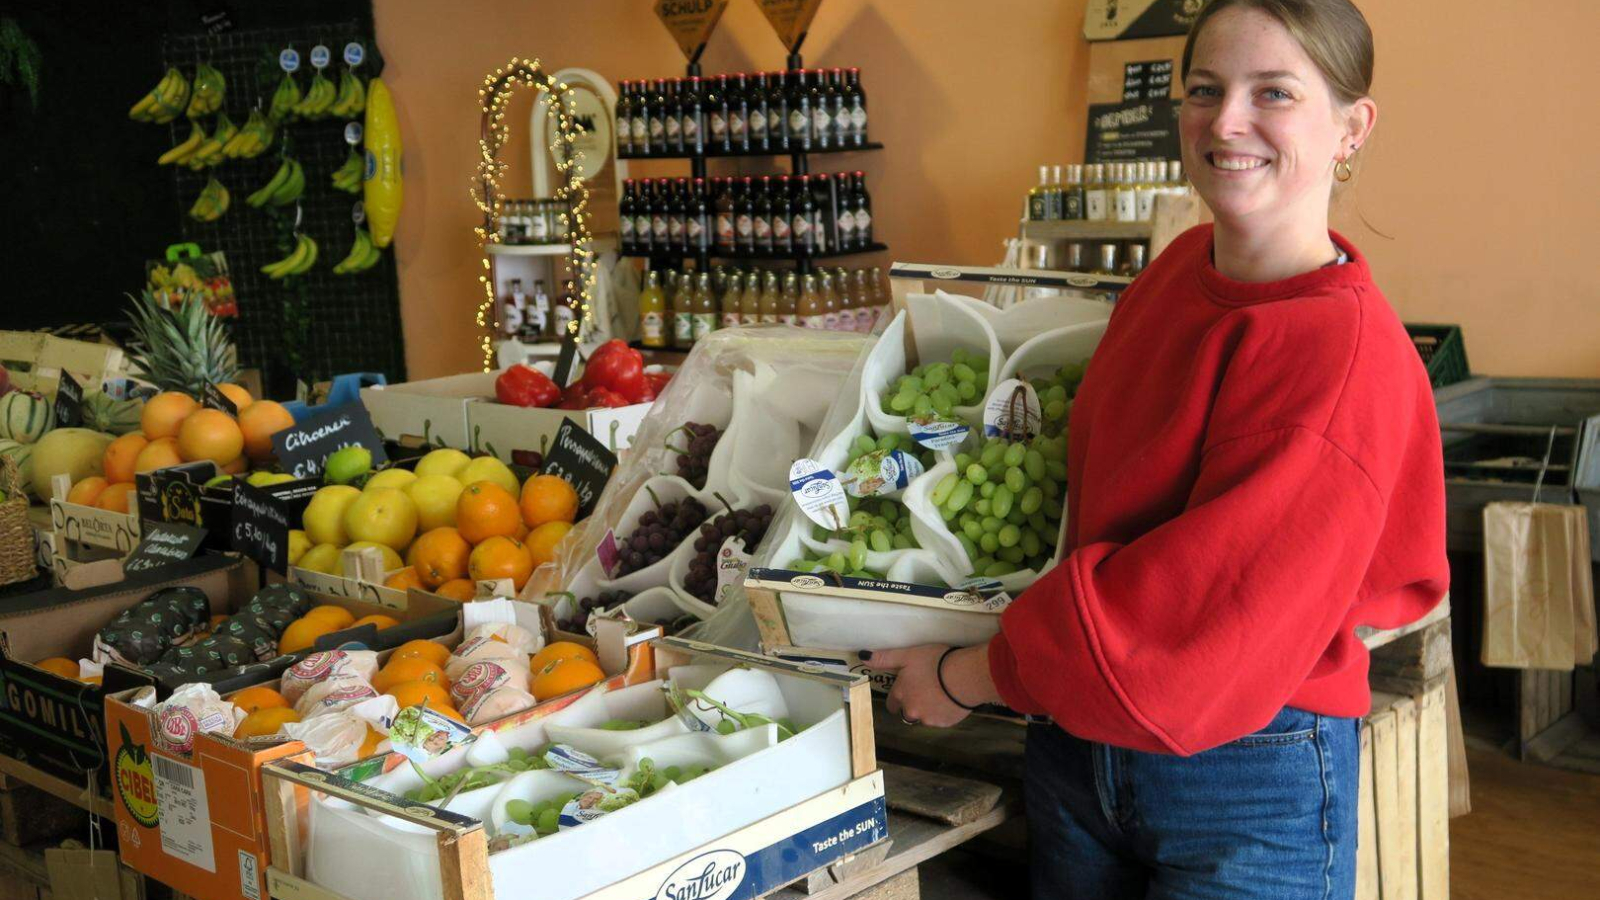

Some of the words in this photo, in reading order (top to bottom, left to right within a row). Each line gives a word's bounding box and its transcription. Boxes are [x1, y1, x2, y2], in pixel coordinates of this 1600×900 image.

[662, 1, 712, 16] SCHULP
[285, 414, 351, 451] Citroenen
[858, 580, 875, 588] SUN
[876, 581, 890, 590] the
[890, 582, 911, 592] Taste
[812, 836, 838, 854] Taste
[838, 828, 855, 842] the
[855, 817, 875, 835] SUN
[665, 861, 741, 900] SanLucar
